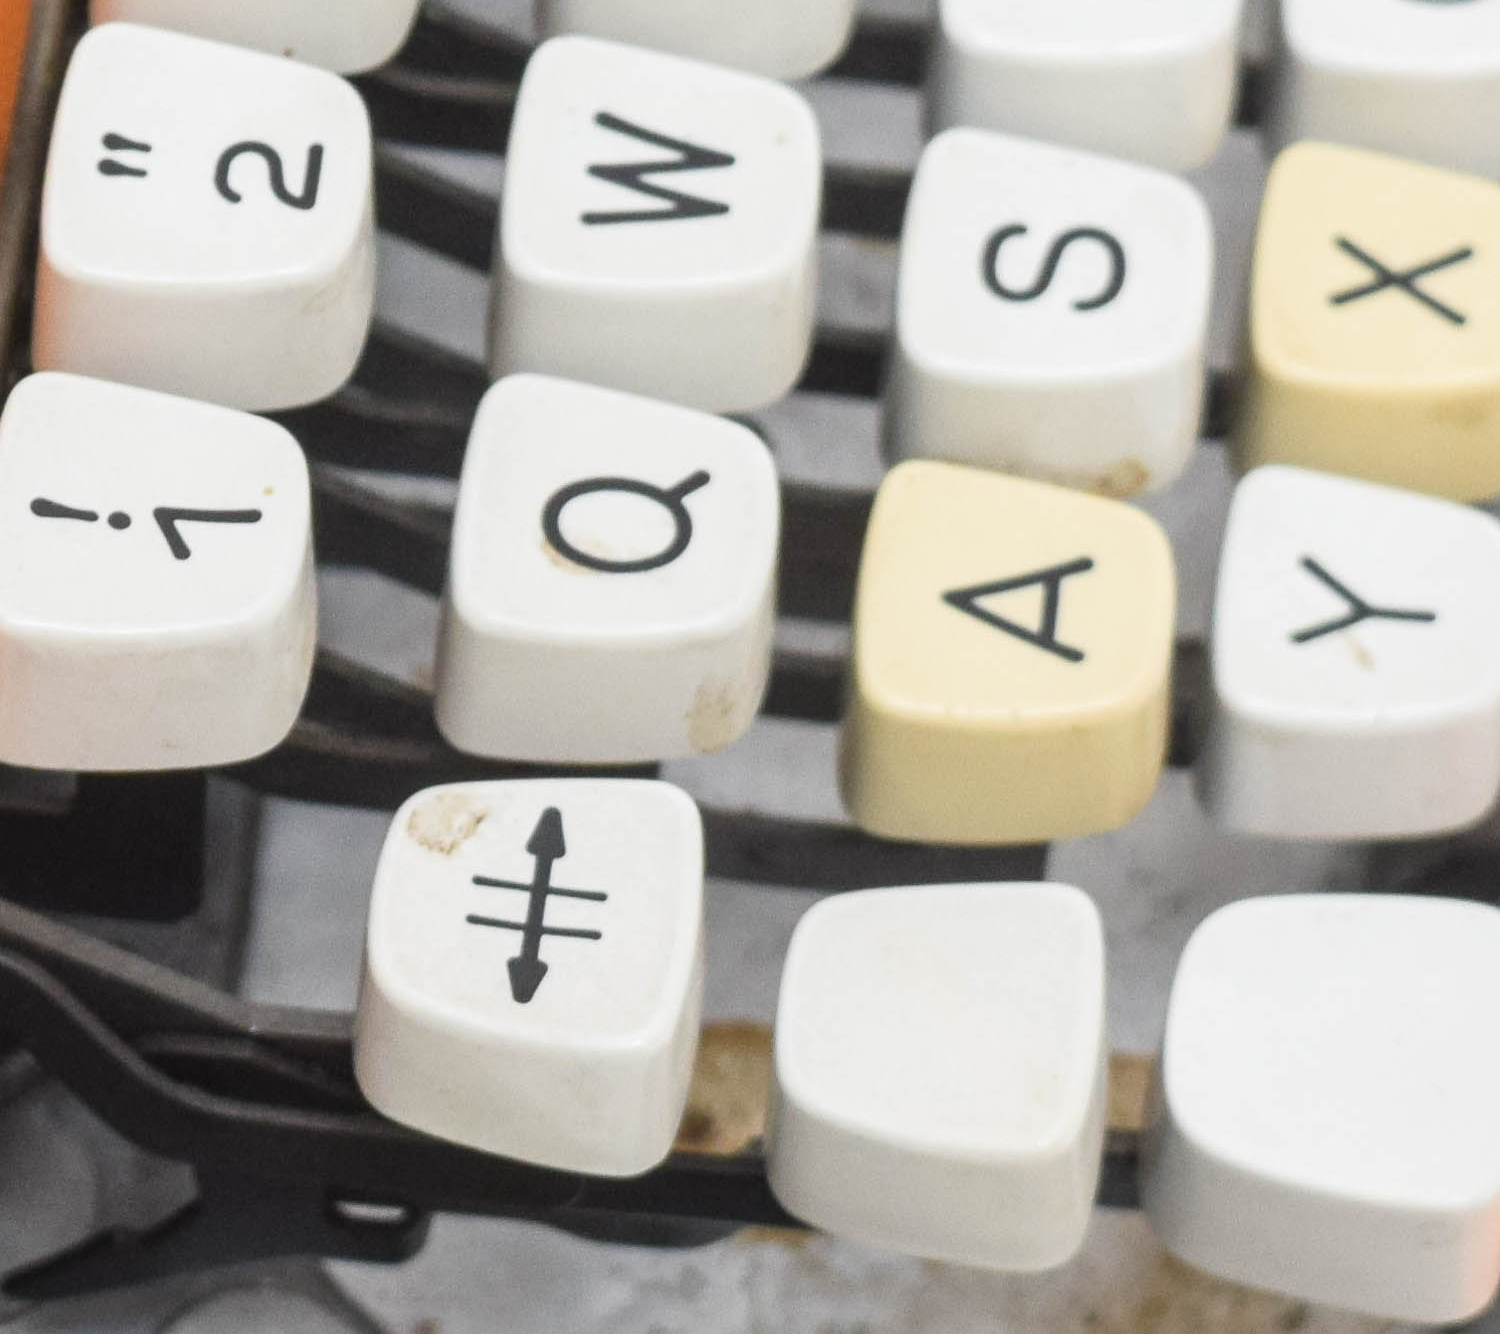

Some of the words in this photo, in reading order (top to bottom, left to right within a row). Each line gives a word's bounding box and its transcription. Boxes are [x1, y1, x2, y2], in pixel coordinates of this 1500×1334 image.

[212, 139, 325, 212] 2
[579, 110, 737, 227] W
[979, 222, 1128, 313] S
[1328, 236, 1475, 328] X
[28, 496, 133, 532] !
[151, 505, 264, 562] 1
[540, 468, 712, 576] Q
[940, 555, 1096, 665] A
[1290, 555, 1438, 645] Y
